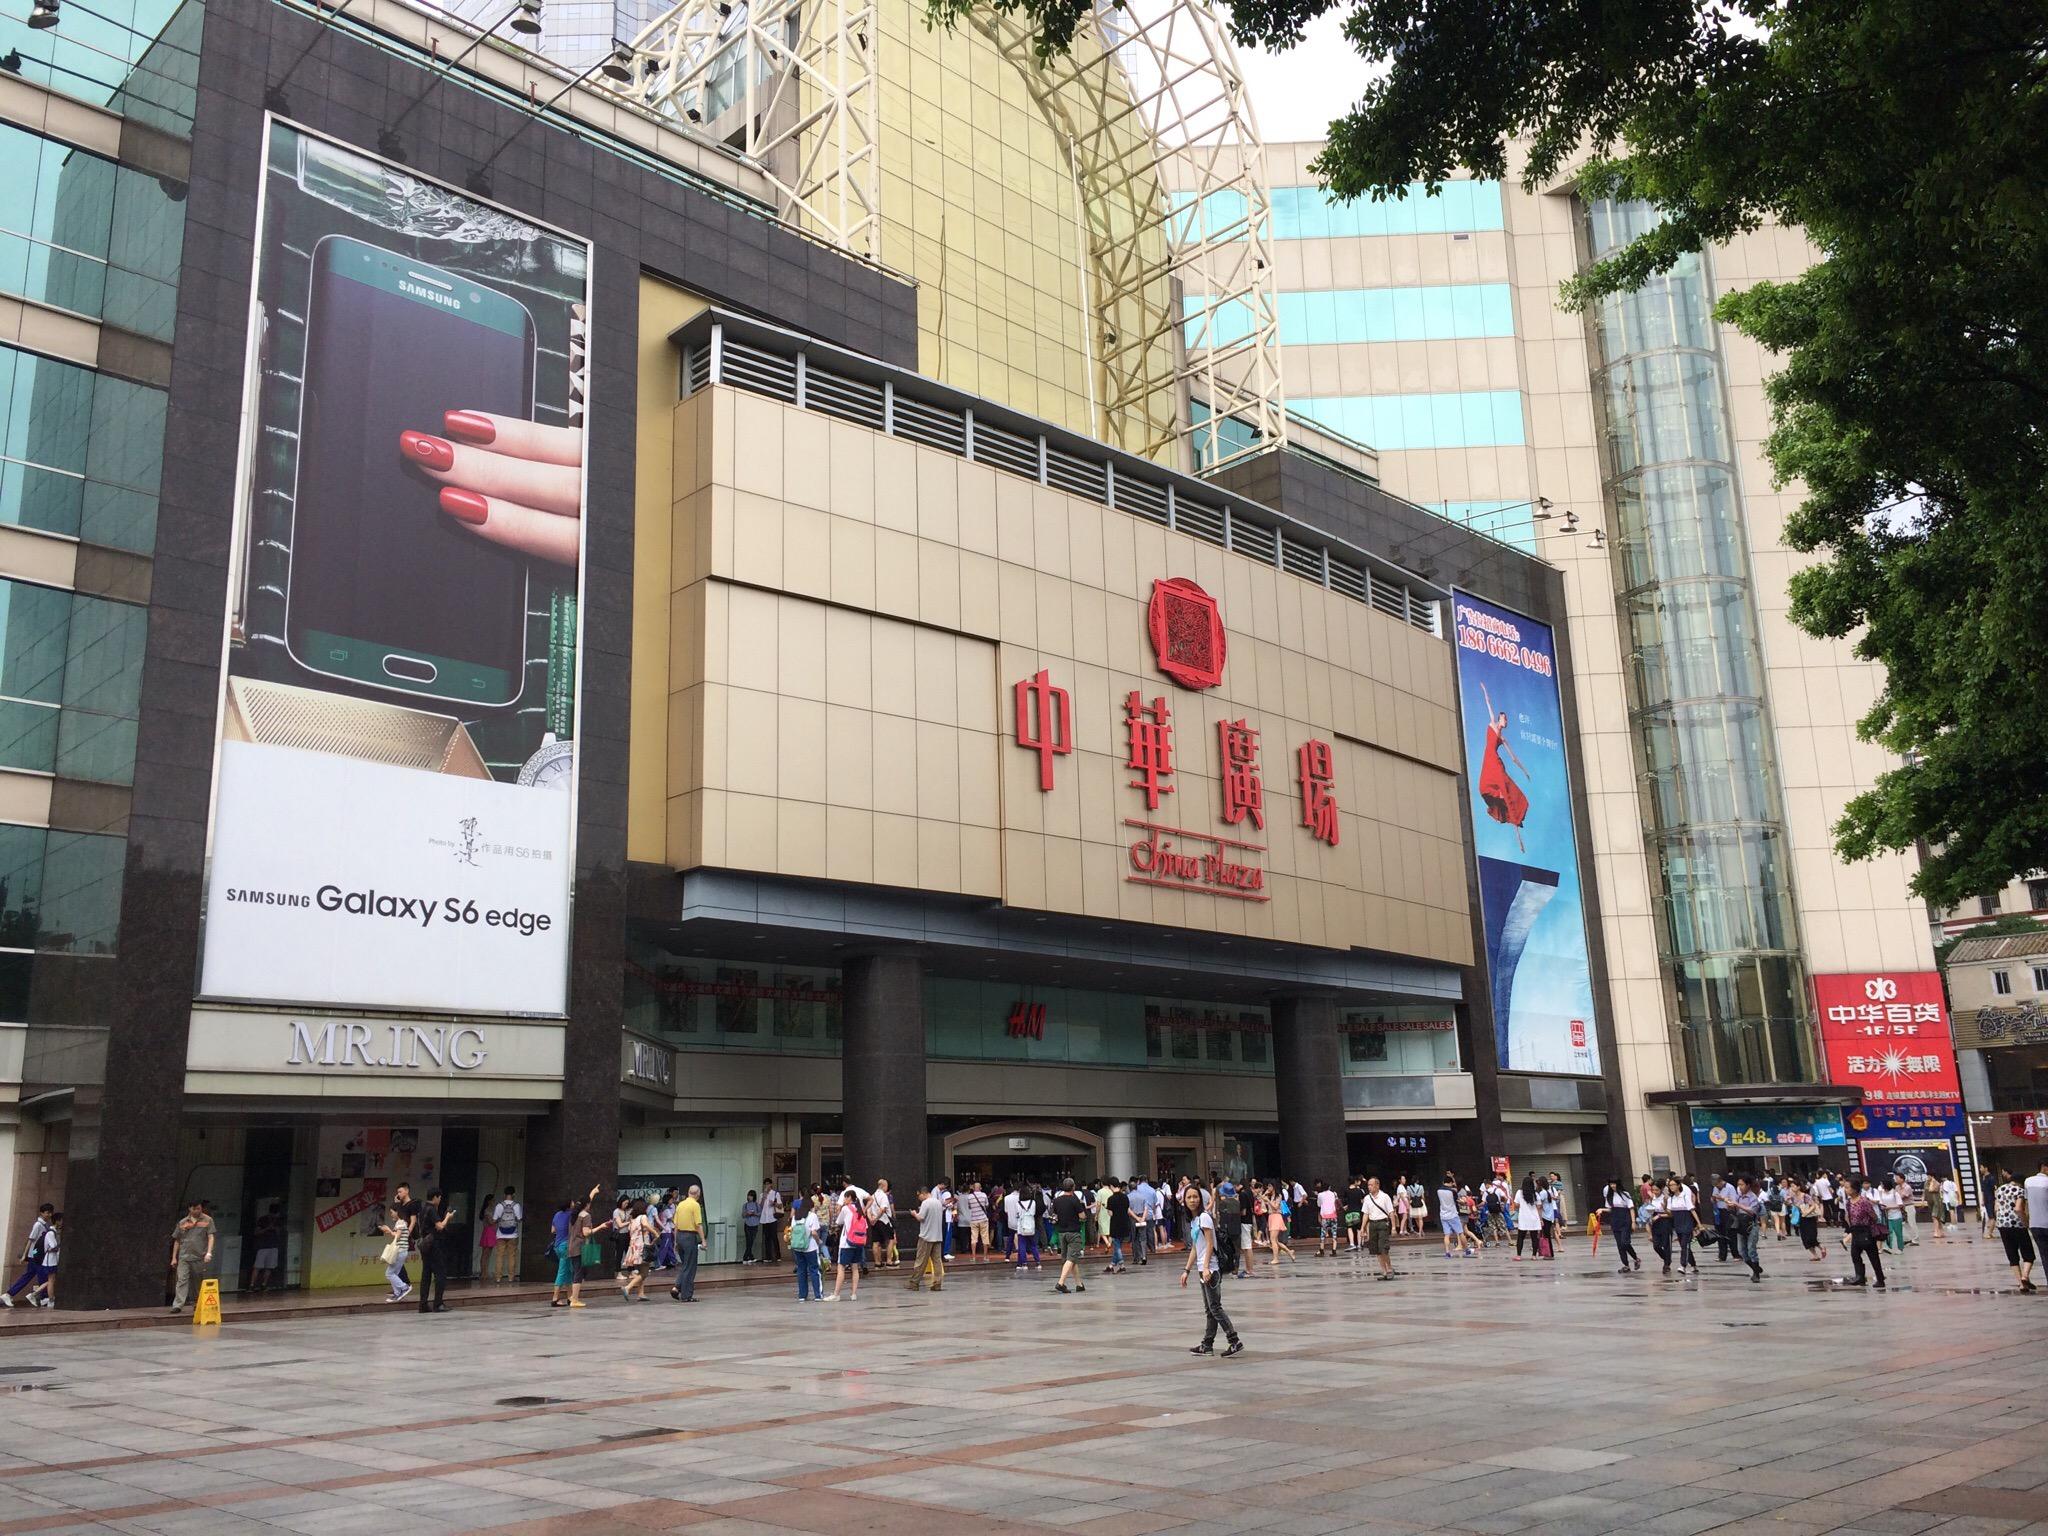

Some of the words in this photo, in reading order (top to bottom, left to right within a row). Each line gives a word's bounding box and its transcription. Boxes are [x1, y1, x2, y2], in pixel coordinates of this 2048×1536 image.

[398, 279, 461, 310] SAMSUNG
[1458, 624, 1486, 653] 186
[1487, 635, 1520, 666] 6662
[1521, 647, 1552, 677] 0496
[428, 837, 446, 847] Photo
[1131, 830, 1200, 880] China
[226, 888, 311, 908] SAMSUNG
[316, 885, 438, 927] Galaxy
[443, 897, 479, 924] S6
[485, 908, 552, 936] edge
[1377, 1023, 1399, 1032] SALE
[1400, 1022, 1422, 1031] SALE
[1423, 1021, 1445, 1030] SALE
[1827, 1003, 1941, 1025] 中华百货
[287, 1020, 488, 1070] MR.ING
